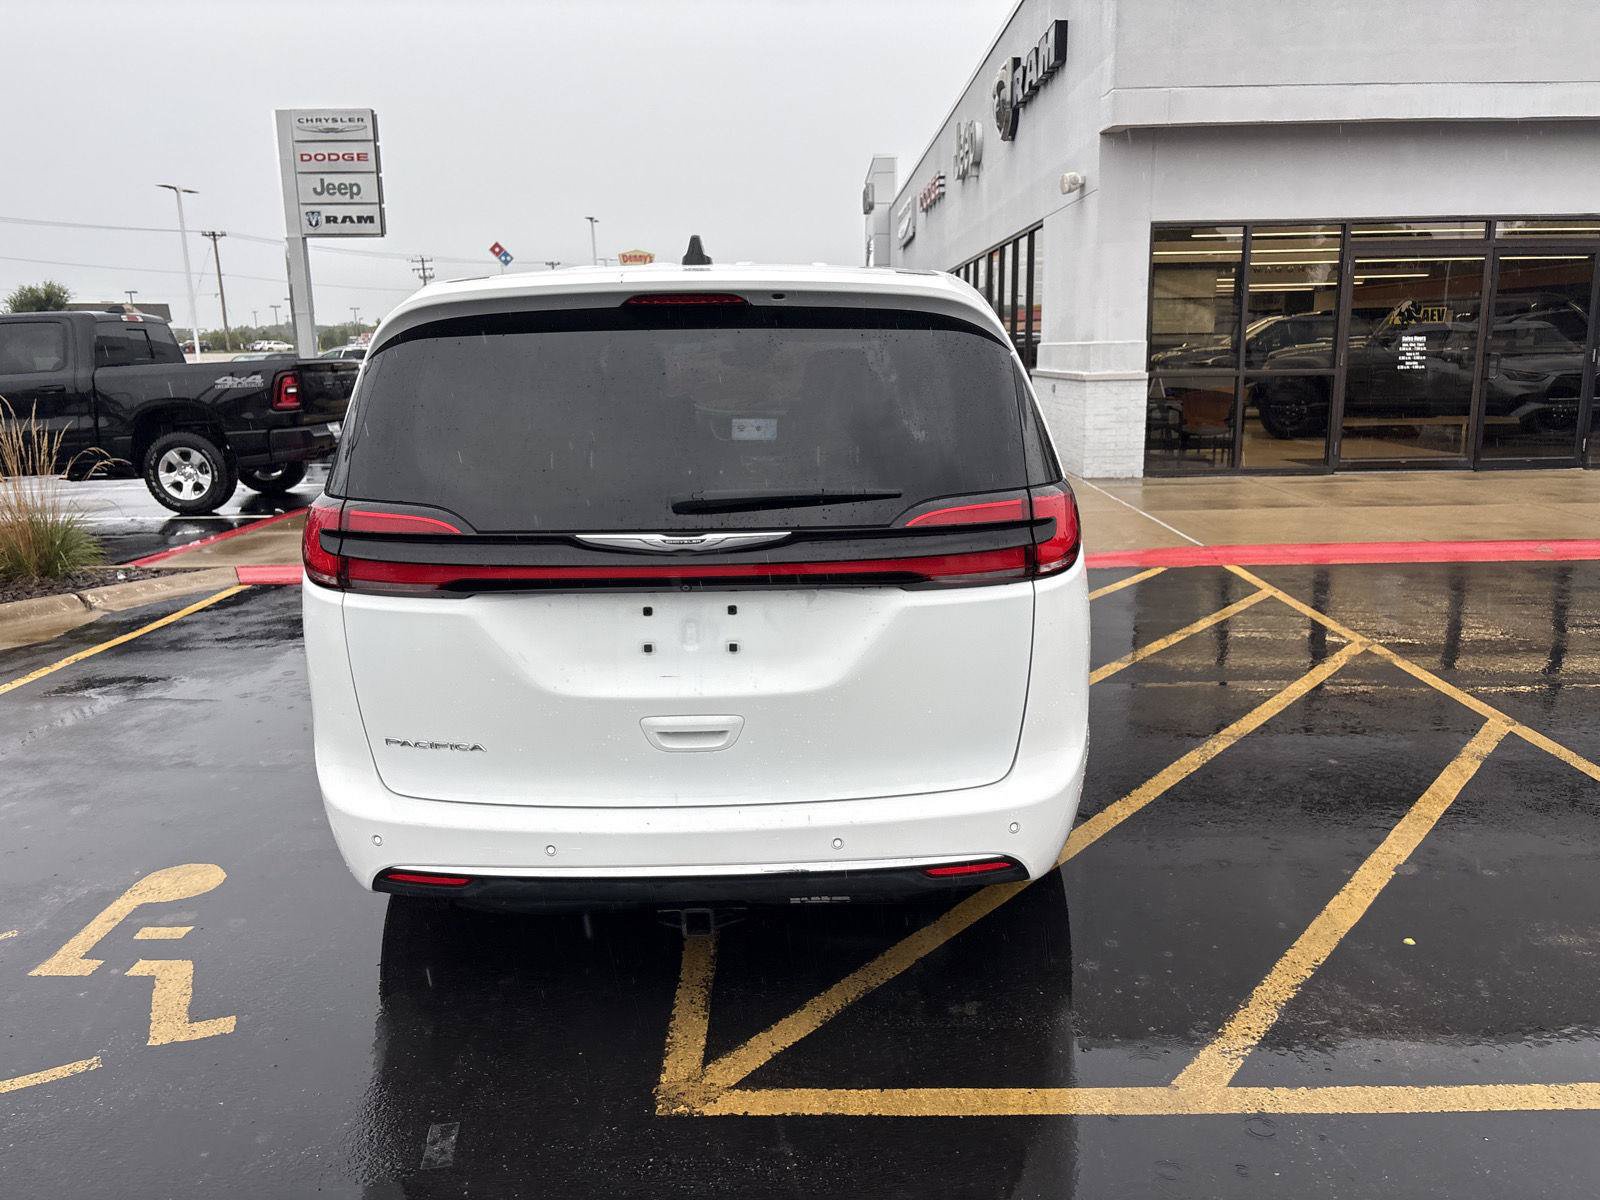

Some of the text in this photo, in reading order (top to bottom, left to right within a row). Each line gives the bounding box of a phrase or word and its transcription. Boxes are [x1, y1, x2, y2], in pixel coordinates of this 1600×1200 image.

[300, 153, 369, 162] DODGE
[312, 178, 362, 199] Jeep
[325, 215, 375, 224] RAM
[1422, 308, 1446, 322] AEV
[385, 738, 487, 752] PACIFICA
